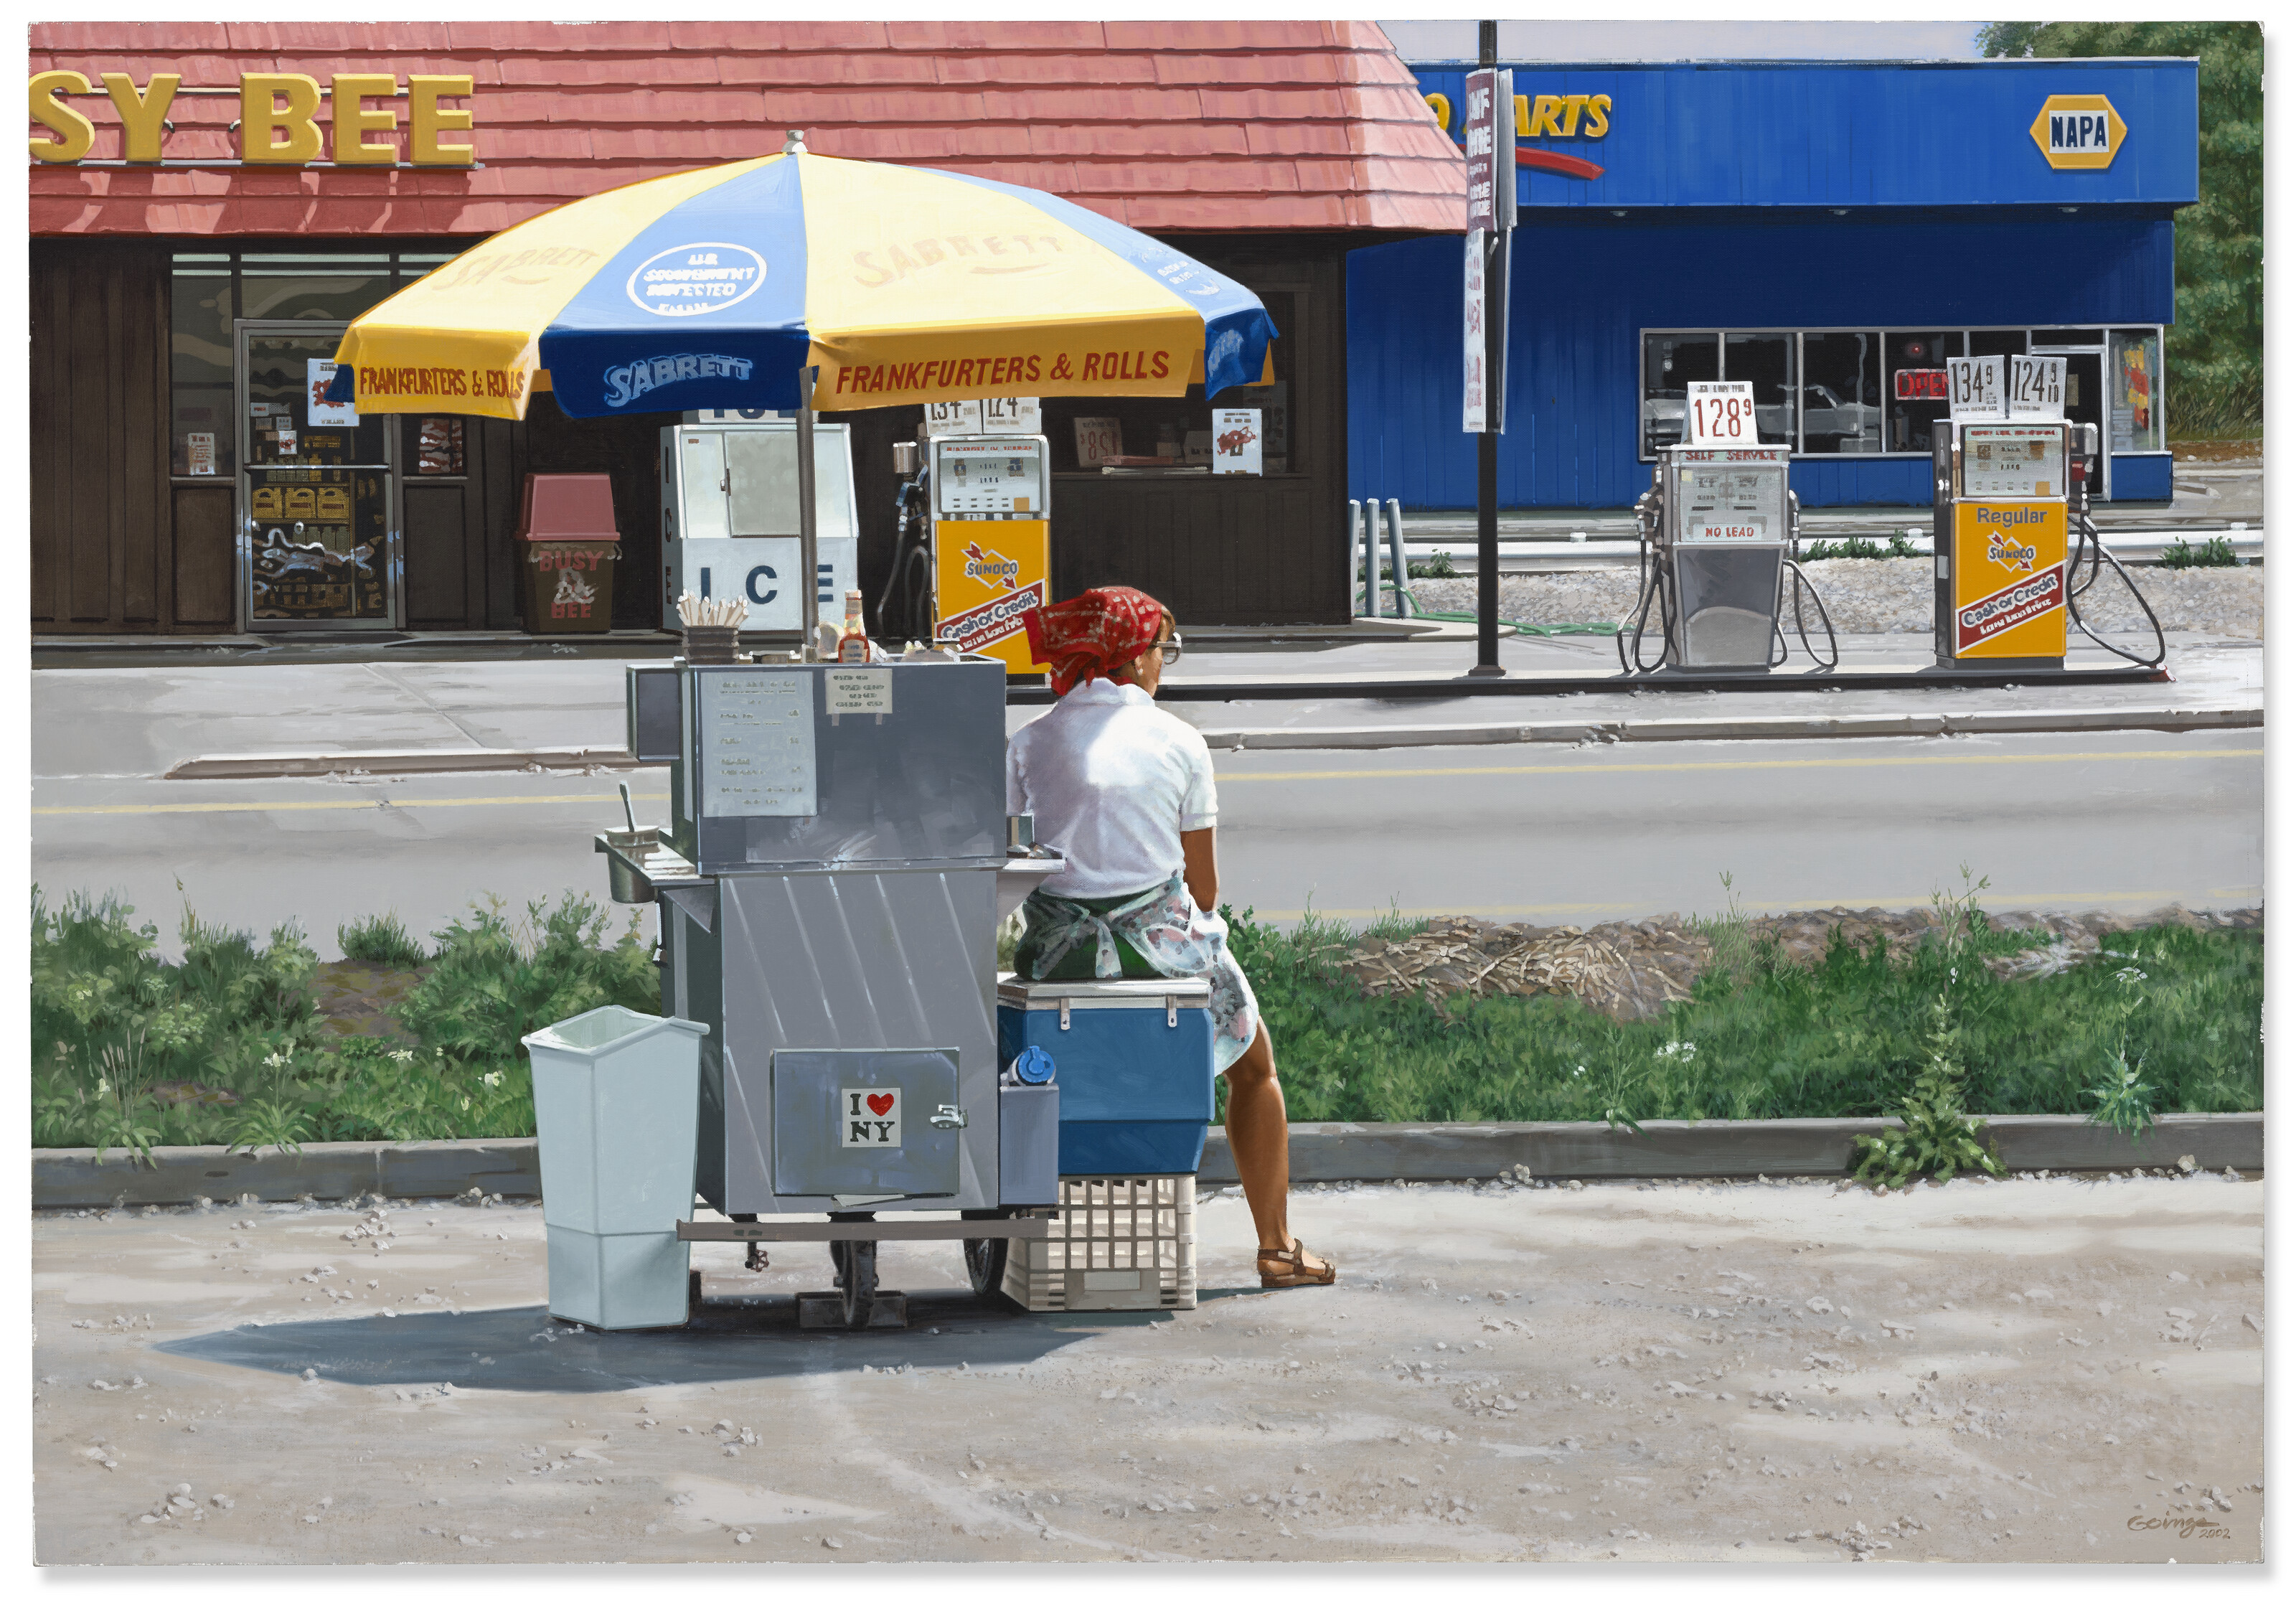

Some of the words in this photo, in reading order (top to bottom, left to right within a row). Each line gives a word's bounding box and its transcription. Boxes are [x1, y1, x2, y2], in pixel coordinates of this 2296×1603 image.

[240, 72, 474, 165] BEE
[1512, 94, 1612, 137] ARTS
[2051, 116, 2107, 147] NAPA
[432, 247, 600, 291] SABRETT
[853, 235, 1063, 288] SABRETT
[360, 367, 467, 396] FRANKFURTERS
[471, 370, 484, 397] &
[603, 353, 753, 407] SABRETT
[836, 354, 1042, 394] FRANKFURTERS
[1050, 352, 1074, 381] &
[1082, 350, 1170, 381] ROLLS
[1685, 450, 1716, 461] SELF
[1726, 449, 1777, 461] SERVICE
[1977, 507, 2048, 528] Regular
[1705, 527, 1721, 537] NO
[1726, 527, 1754, 537] LEAD
[539, 550, 604, 571] BUSY
[1989, 547, 2034, 560] SUNOCO
[967, 562, 1018, 575] SUNOCO
[551, 601, 592, 619] BEE
[1964, 602, 1995, 626] Cash
[1999, 596, 2013, 608] or
[2014, 576, 2058, 601] Credit
[943, 617, 979, 639] Cash
[979, 611, 993, 626] or
[994, 592, 1038, 619] Credit
[850, 1093, 862, 1116] I
[850, 1121, 895, 1142] NY
[2198, 1528, 2231, 1540] 2002
